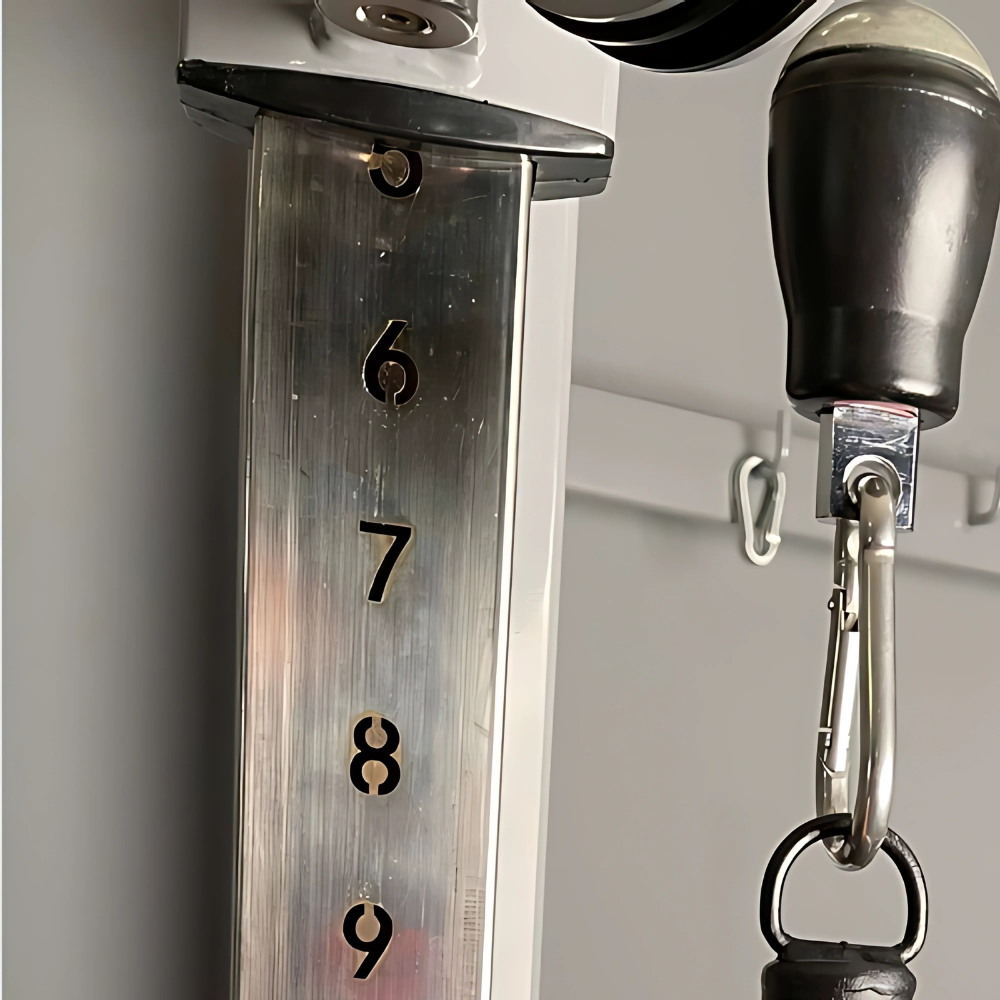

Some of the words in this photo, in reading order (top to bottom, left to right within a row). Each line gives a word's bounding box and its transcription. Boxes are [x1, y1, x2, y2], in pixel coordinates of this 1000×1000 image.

[368, 143, 422, 198] 5
[363, 320, 420, 405] 6
[359, 520, 412, 602] 7
[349, 715, 401, 796] 8
[342, 902, 394, 980] 9
